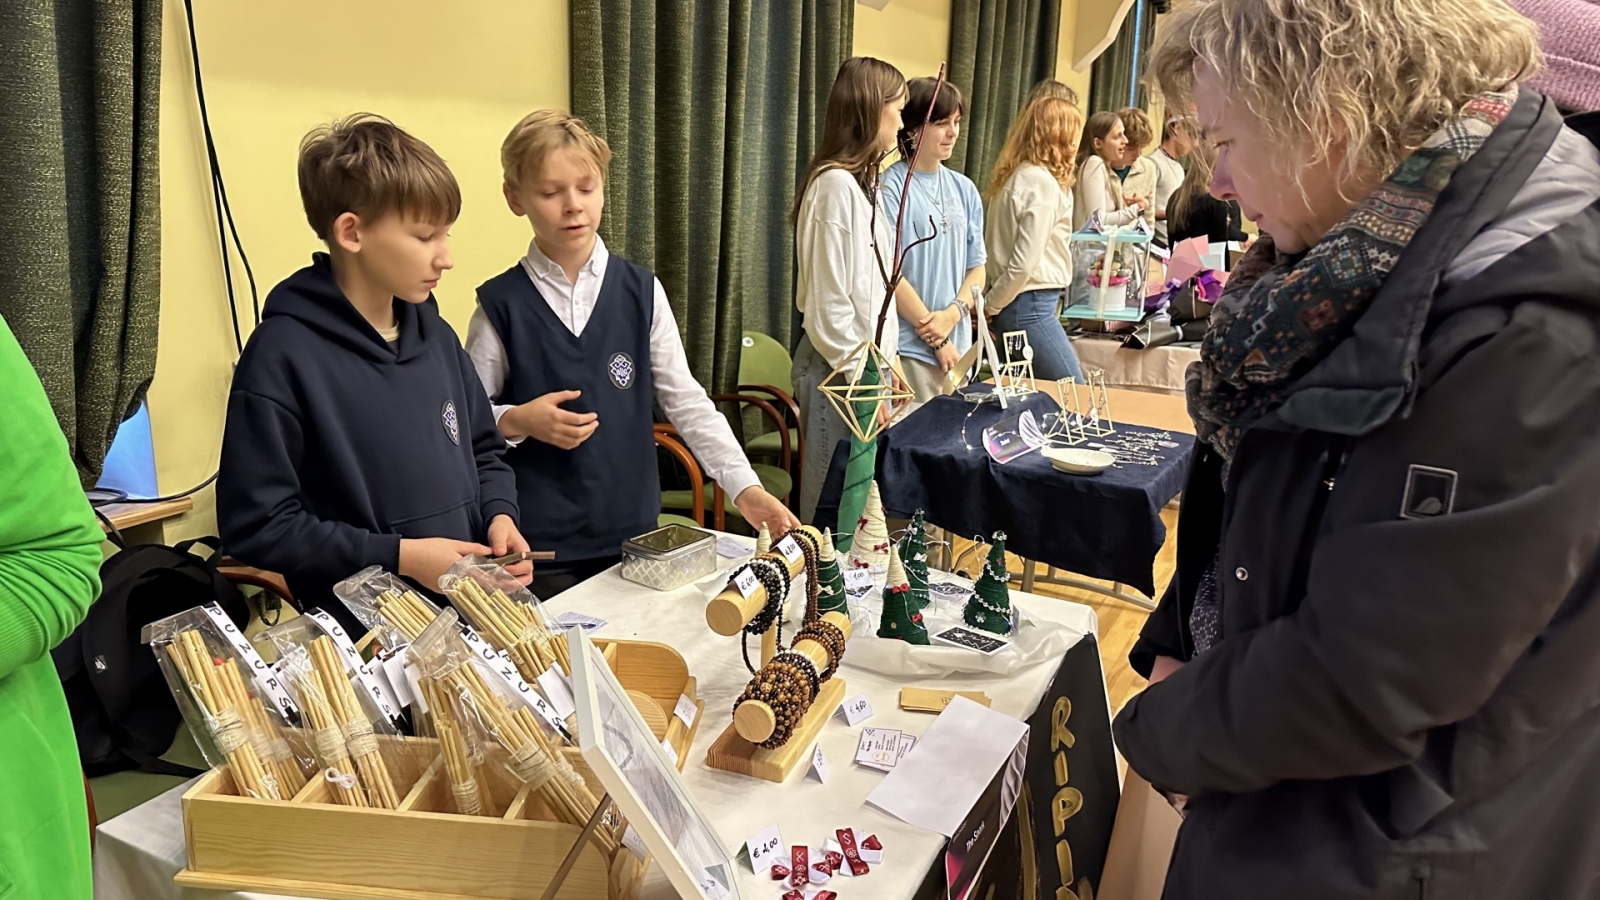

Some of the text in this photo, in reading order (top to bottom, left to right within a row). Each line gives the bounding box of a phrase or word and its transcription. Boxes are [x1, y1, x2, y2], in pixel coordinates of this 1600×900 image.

[209, 606, 291, 708] PUZURS
[317, 613, 391, 714] PUZURS
[467, 632, 562, 727] PUZURS
